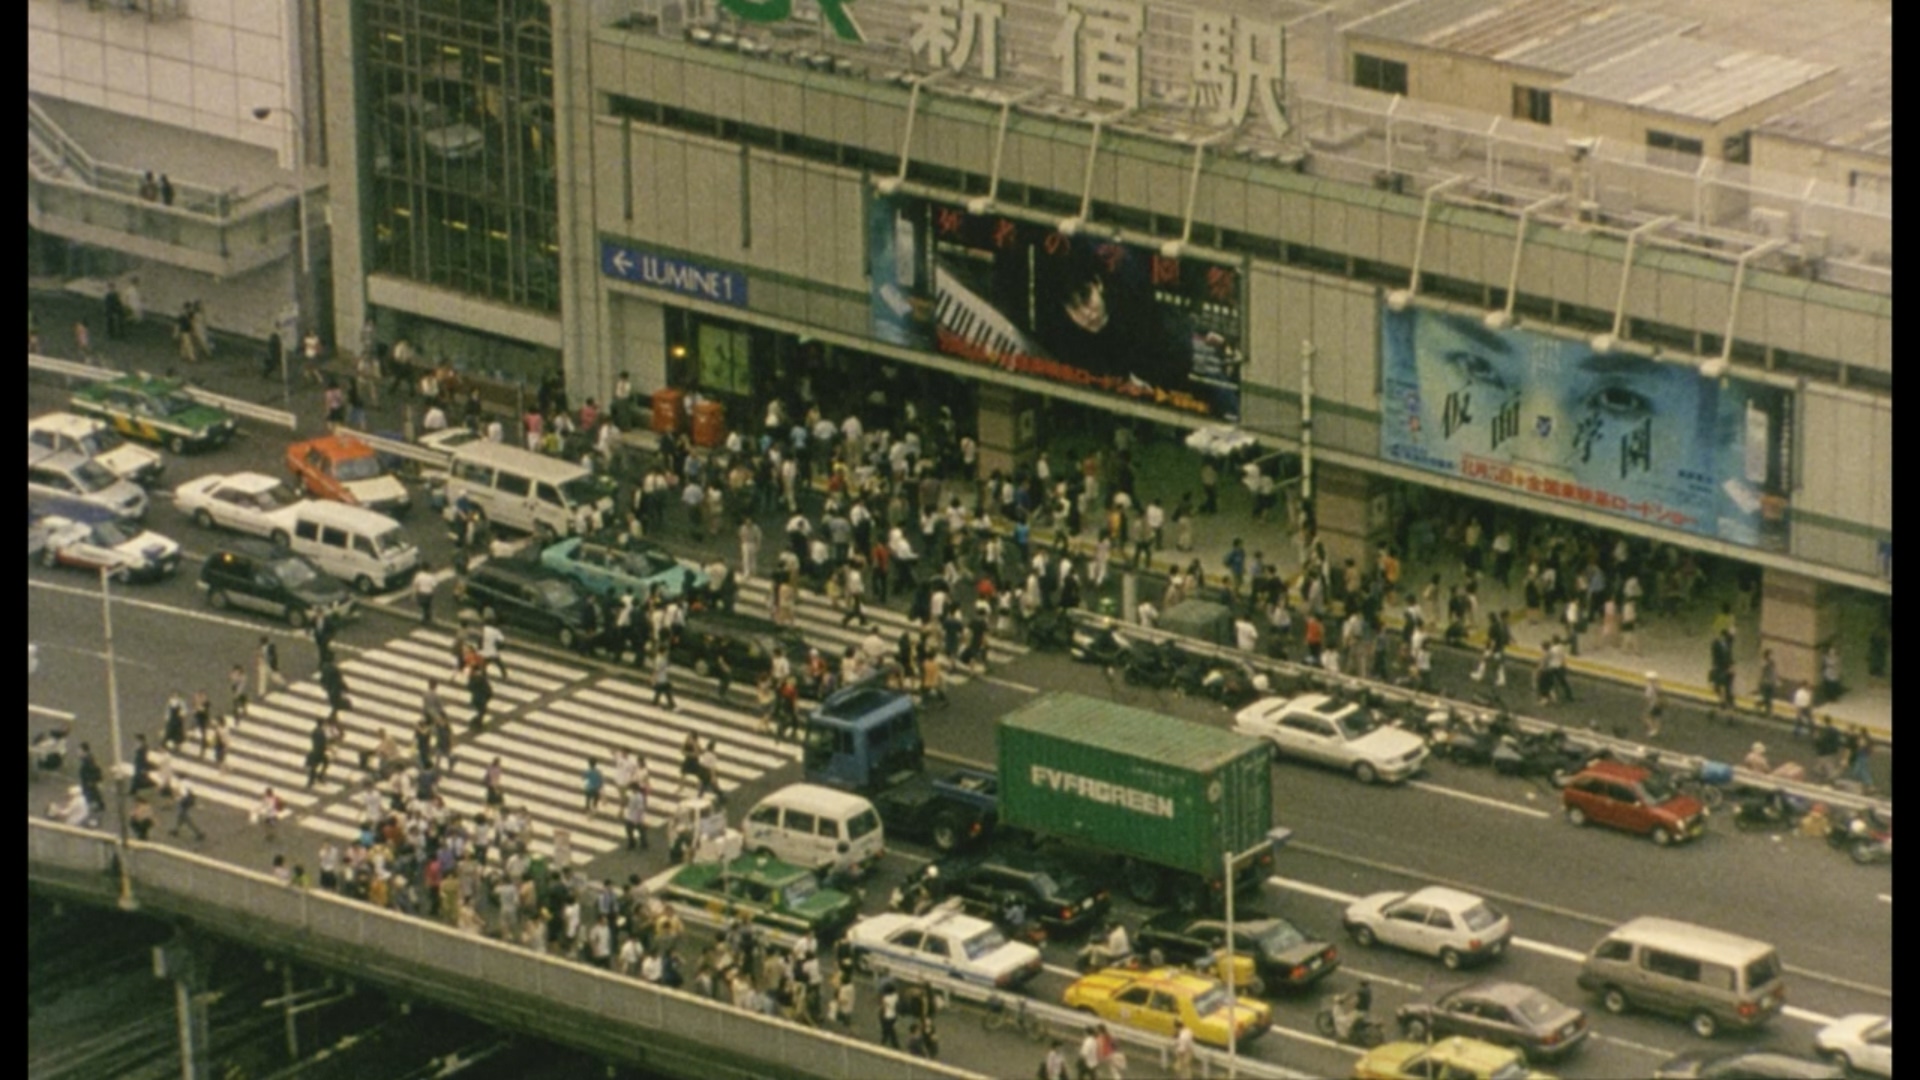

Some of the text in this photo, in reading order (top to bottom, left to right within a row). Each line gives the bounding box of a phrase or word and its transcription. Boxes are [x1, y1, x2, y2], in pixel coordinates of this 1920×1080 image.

[909, 0, 1290, 137] 新宿駅
[643, 256, 719, 297] LUMINE
